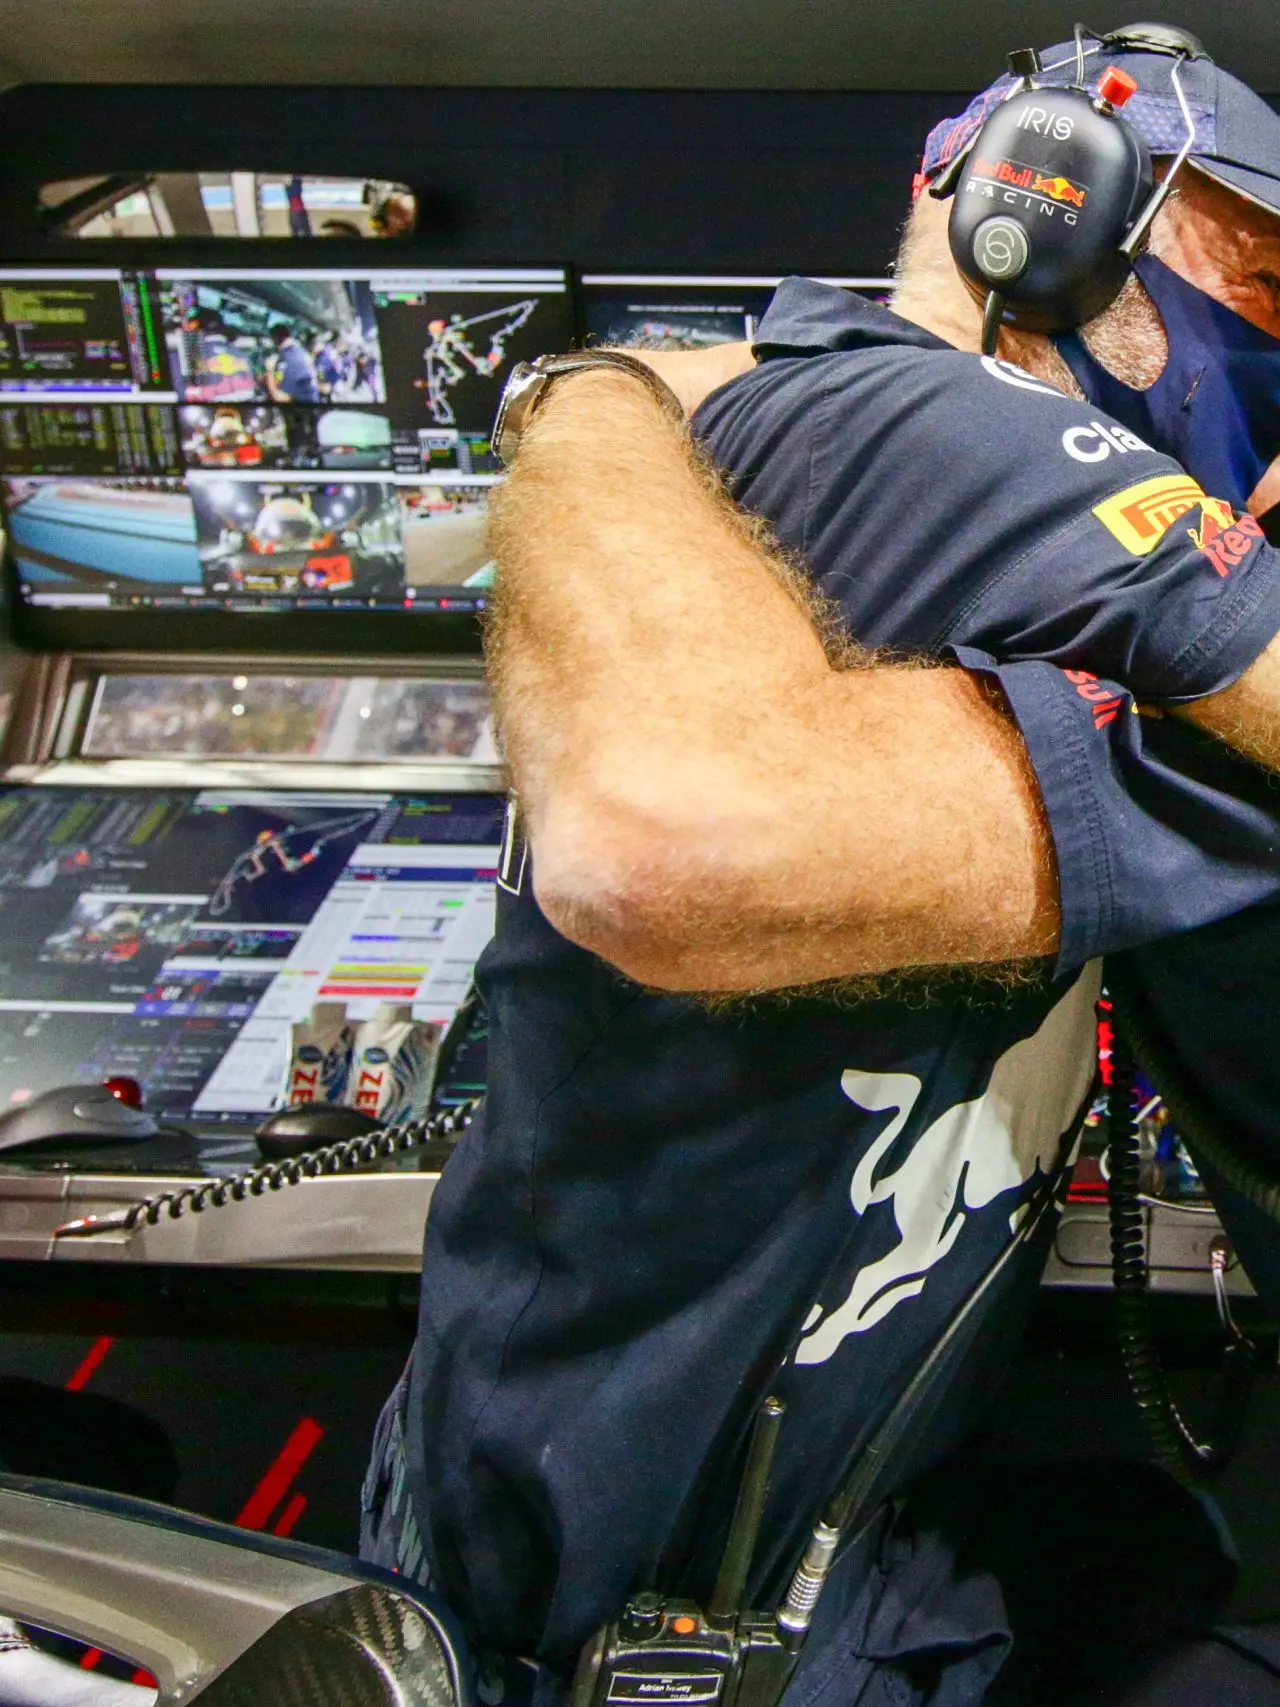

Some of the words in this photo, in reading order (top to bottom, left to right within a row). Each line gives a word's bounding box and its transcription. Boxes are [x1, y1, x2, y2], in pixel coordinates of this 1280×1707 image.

[1017, 106, 1075, 141] IRIS
[966, 180, 1079, 226] RACING
[639, 1683, 665, 1692] Adrian
